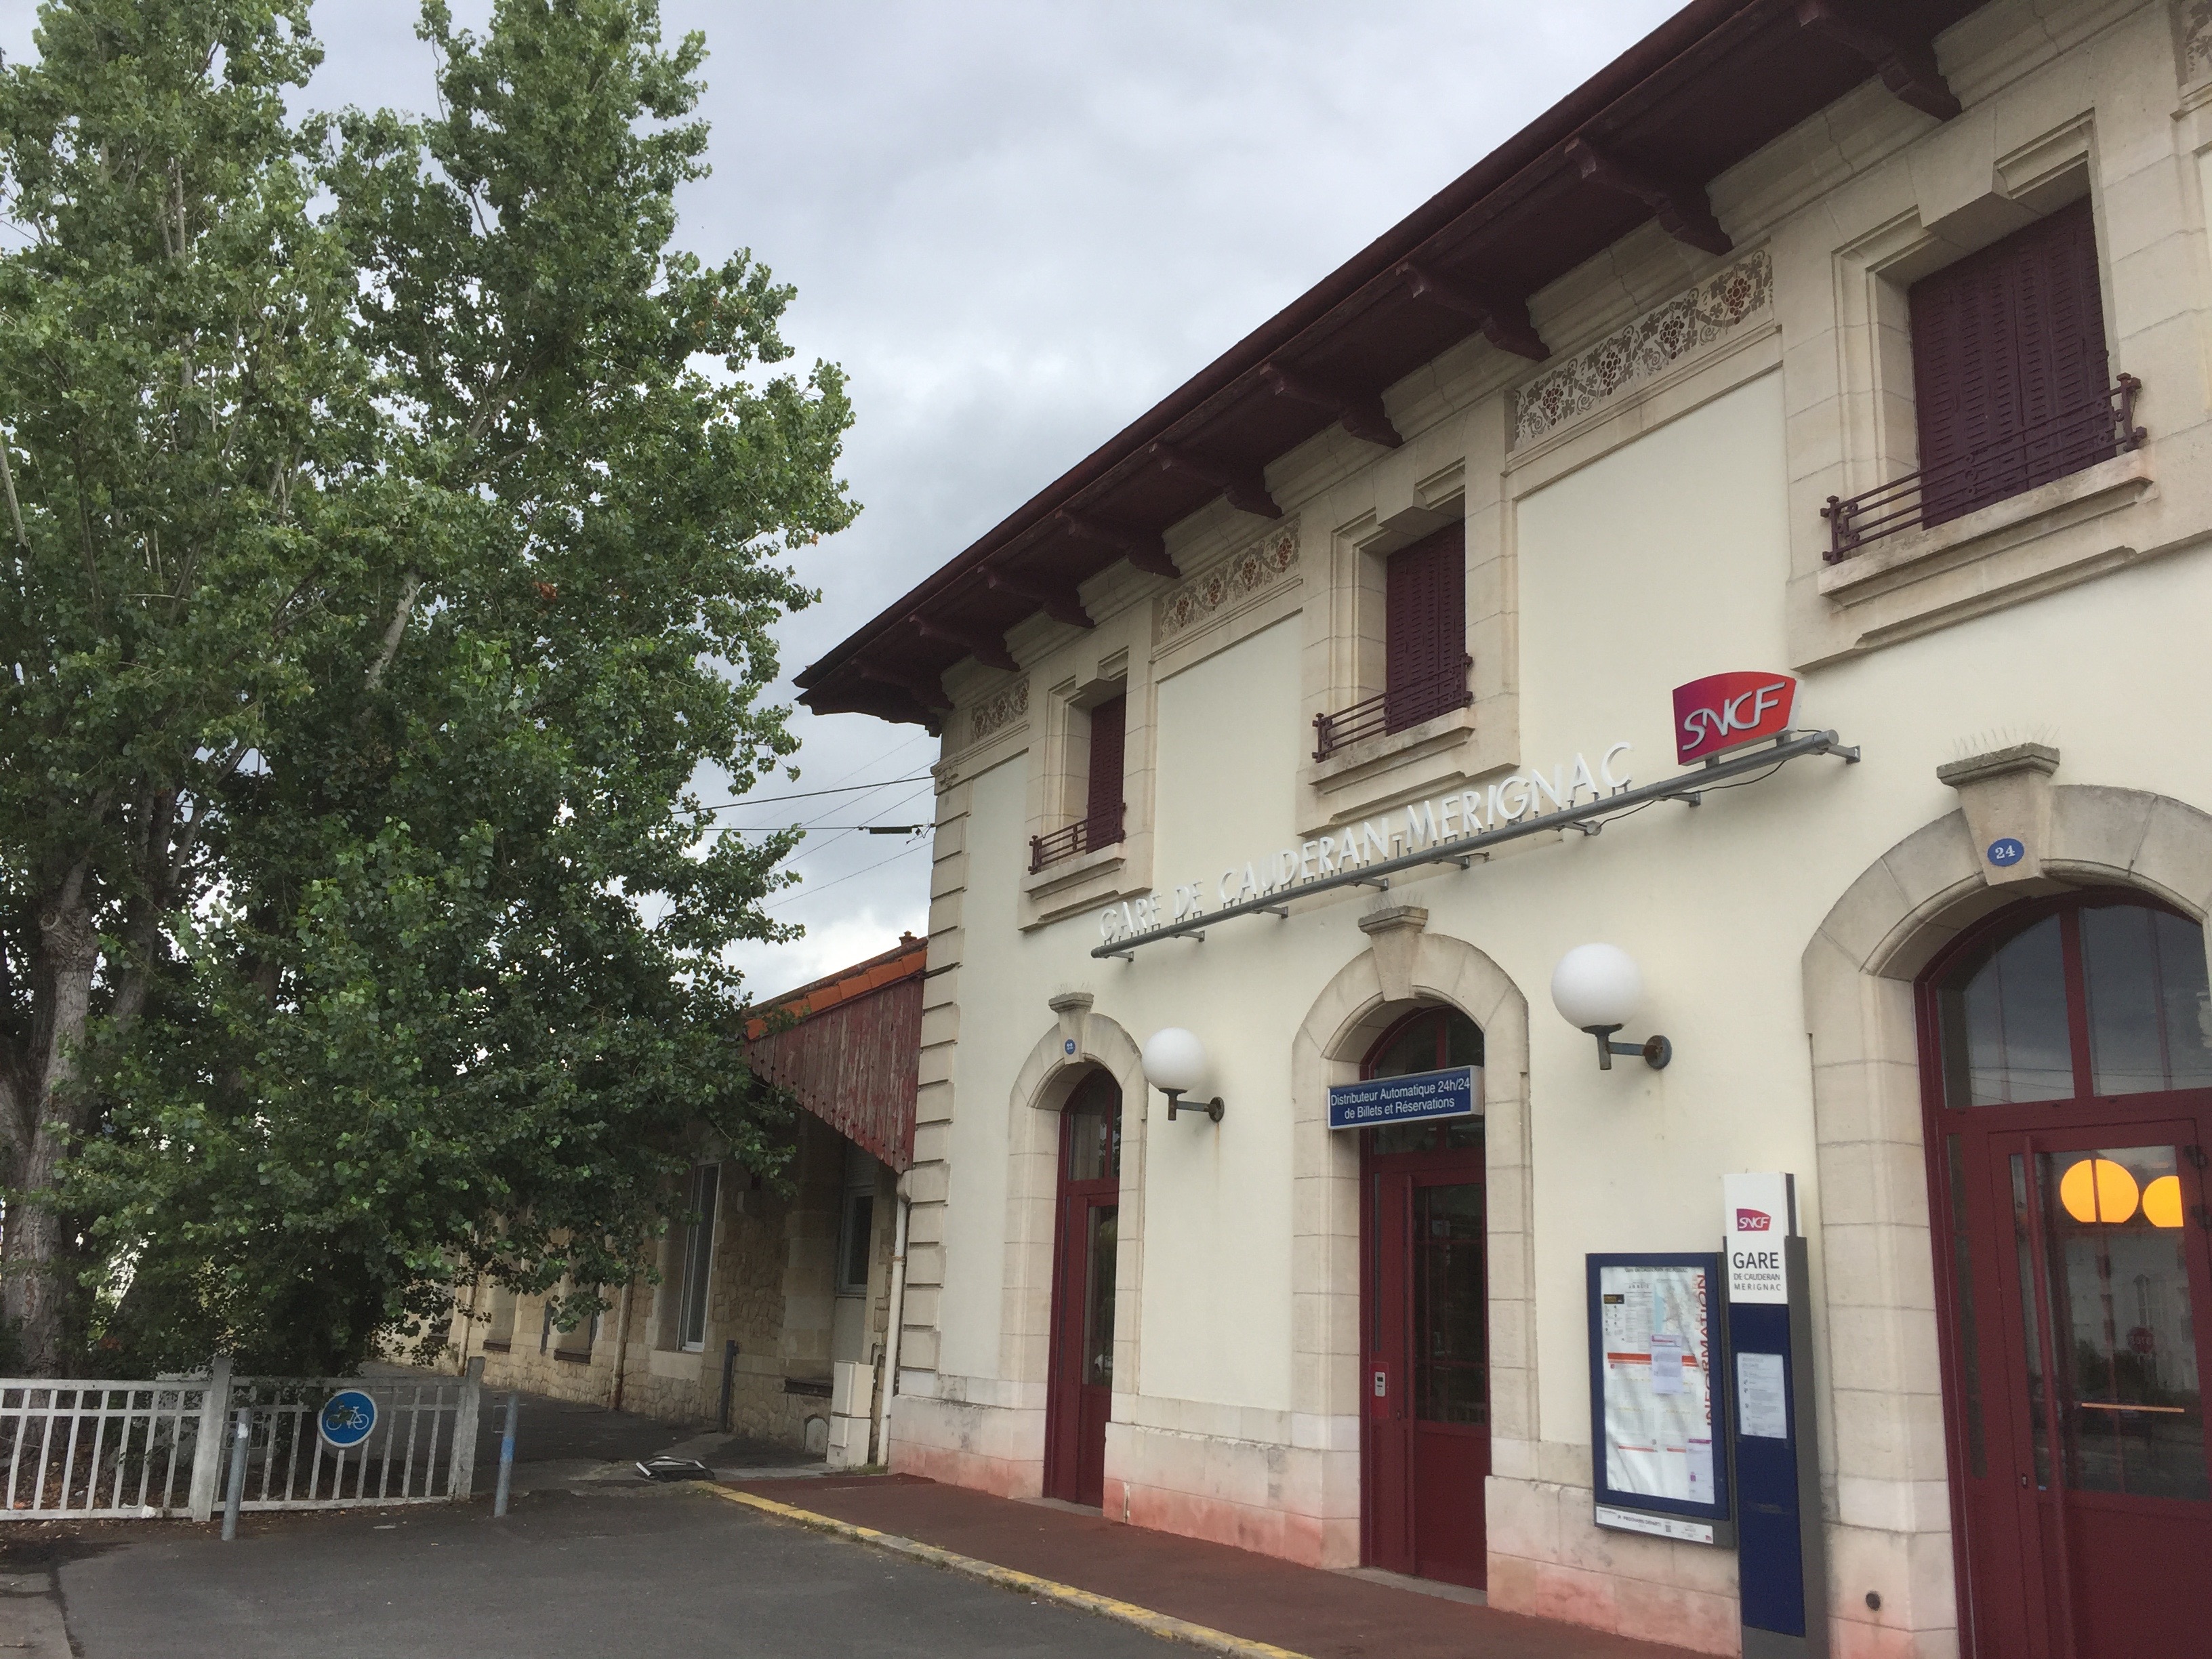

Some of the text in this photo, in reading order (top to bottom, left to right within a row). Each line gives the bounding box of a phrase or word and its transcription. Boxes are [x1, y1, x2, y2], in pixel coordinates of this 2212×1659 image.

[1682, 681, 1786, 751] SNCF
[1994, 844, 2016, 860] 24
[1100, 892, 1162, 941] GARE
[1173, 878, 1204, 919] DE
[1330, 1077, 1471, 1107] Distributeur Automatique 24h/24
[1344, 1097, 1455, 1120] de Billets et Réservations
[1738, 1216, 1770, 1229] SNCF
[1733, 1252, 1780, 1269] GARE
[1734, 1273, 1781, 1281] DE CAUDERAN
[1734, 1283, 1782, 1291] MERIGNAC
